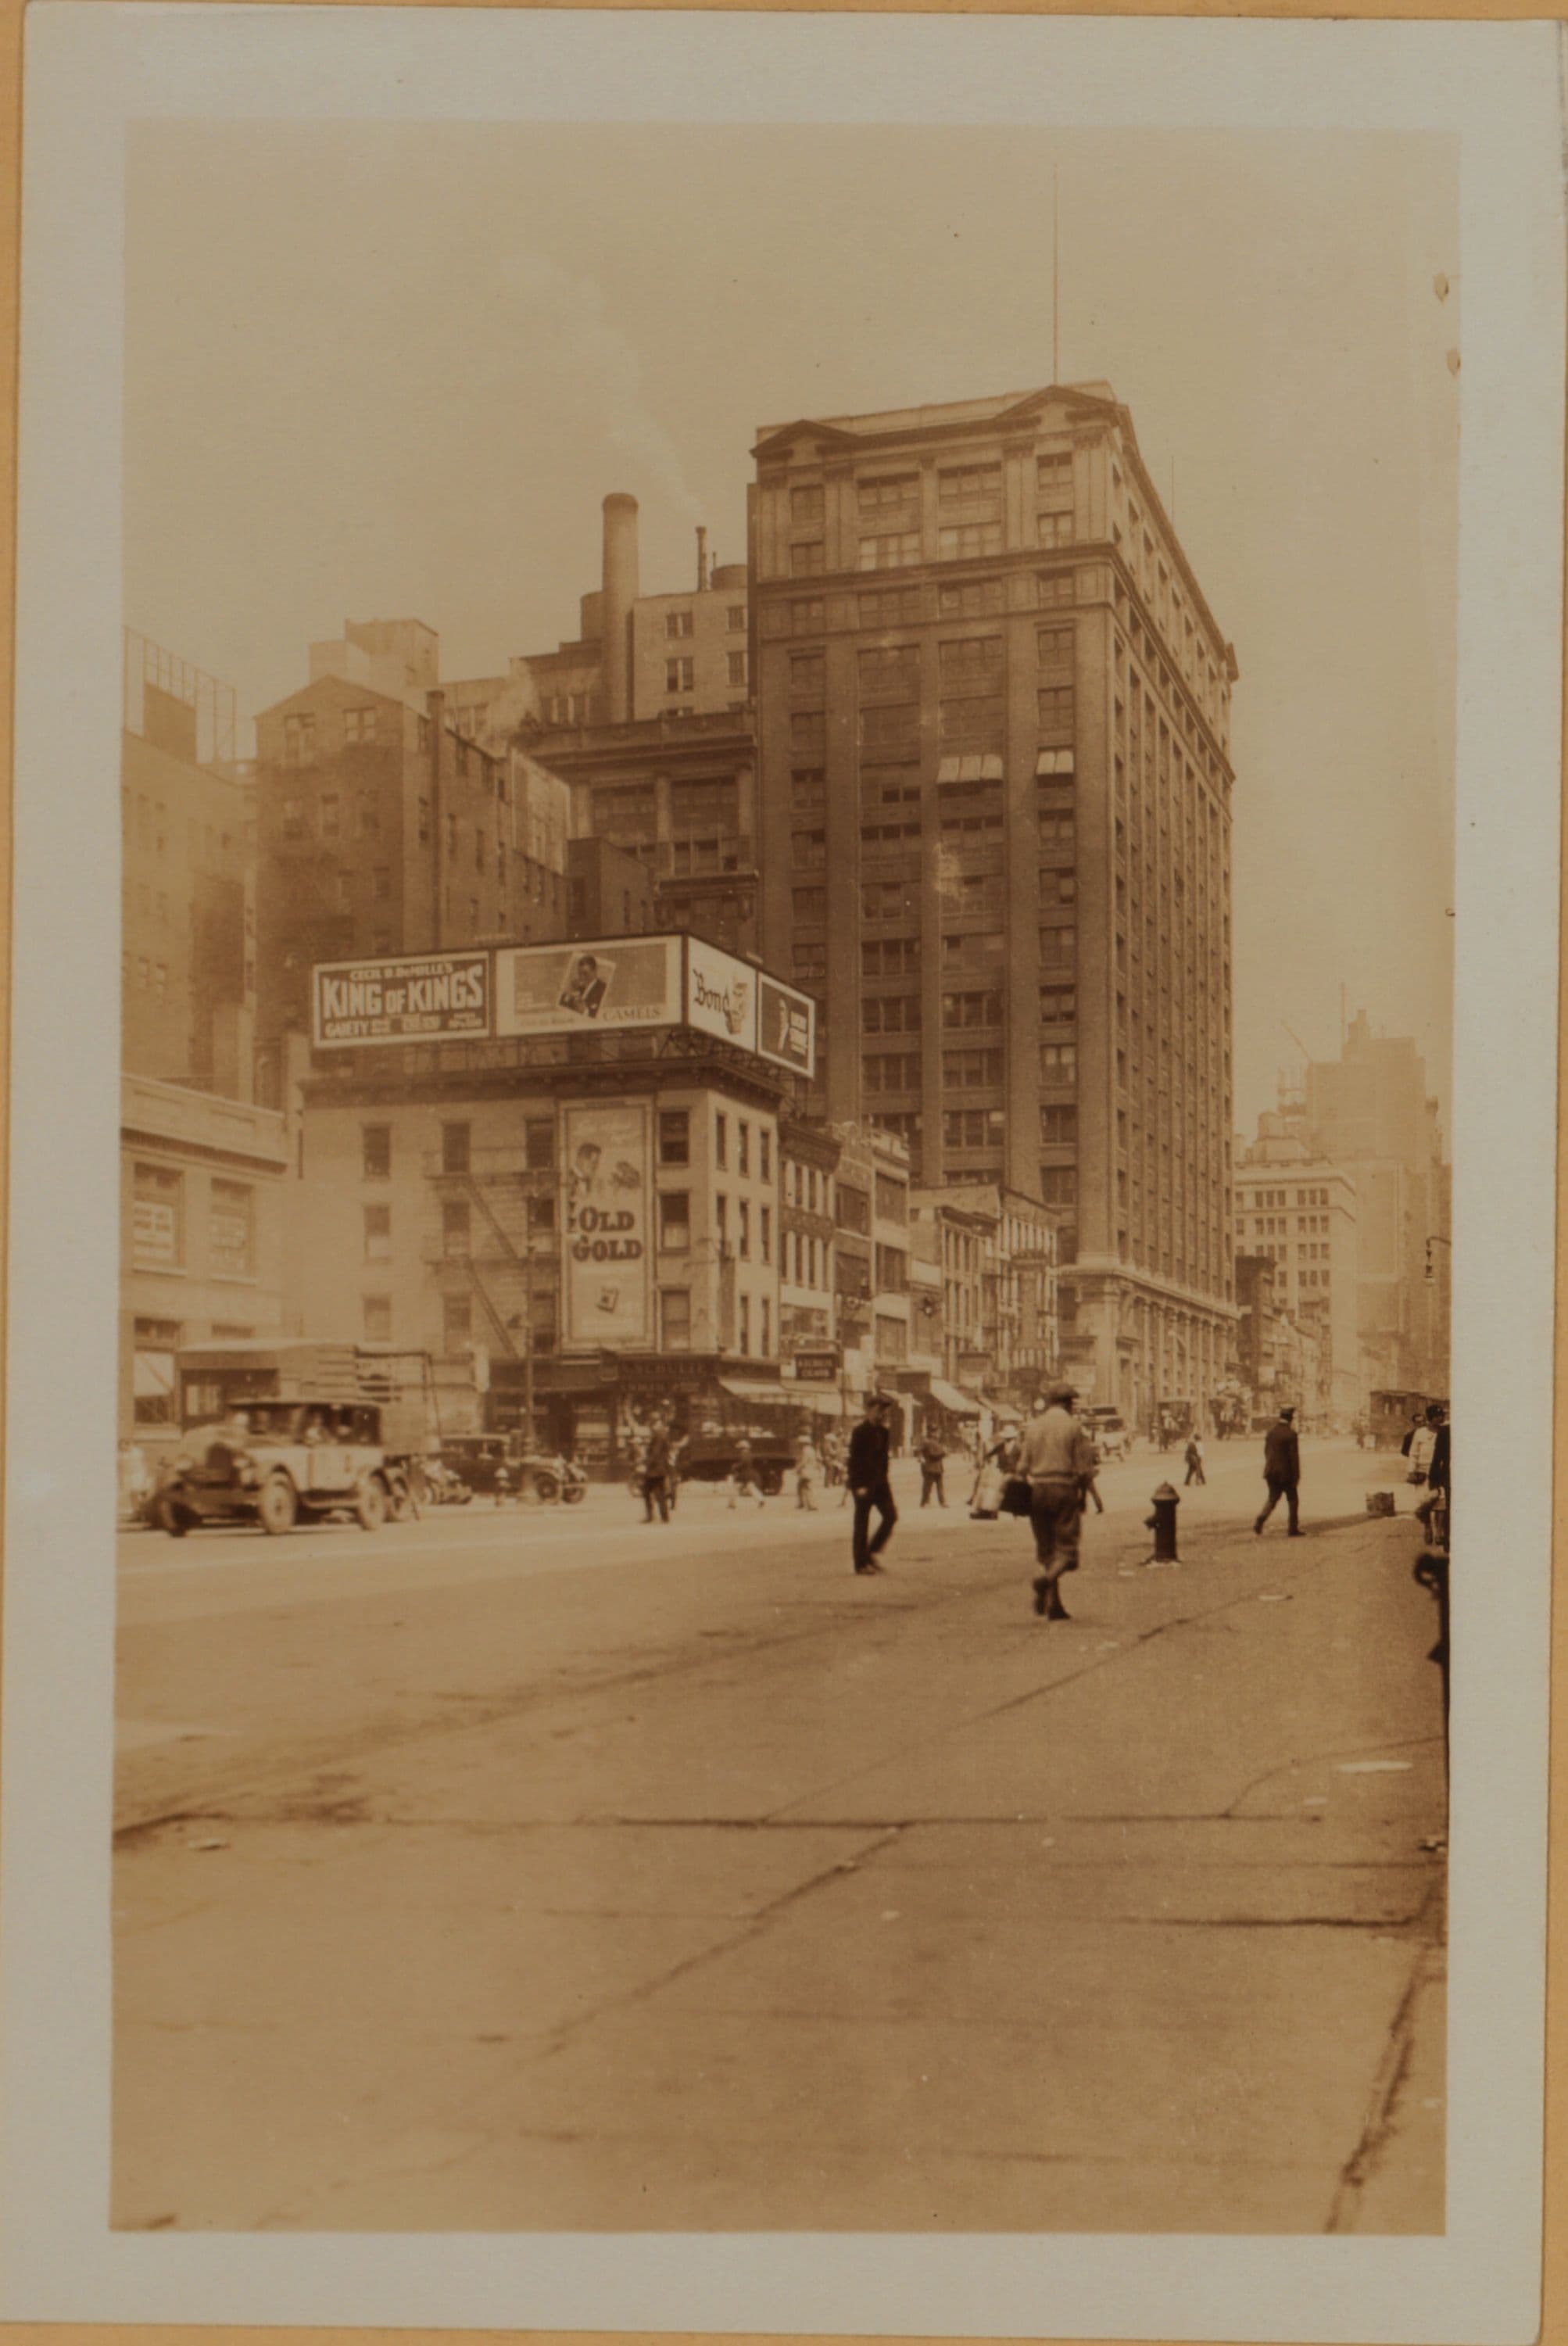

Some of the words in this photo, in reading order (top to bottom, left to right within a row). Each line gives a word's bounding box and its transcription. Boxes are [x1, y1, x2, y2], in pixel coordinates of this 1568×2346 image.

[350, 969, 382, 981] CECIL
[323, 977, 381, 1019] KING
[385, 989, 406, 1014] OF
[407, 965, 483, 1012] KINGS
[693, 969, 730, 1015] Bond
[579, 1207, 635, 1231] OLD
[572, 1235, 643, 1261] GOLD
